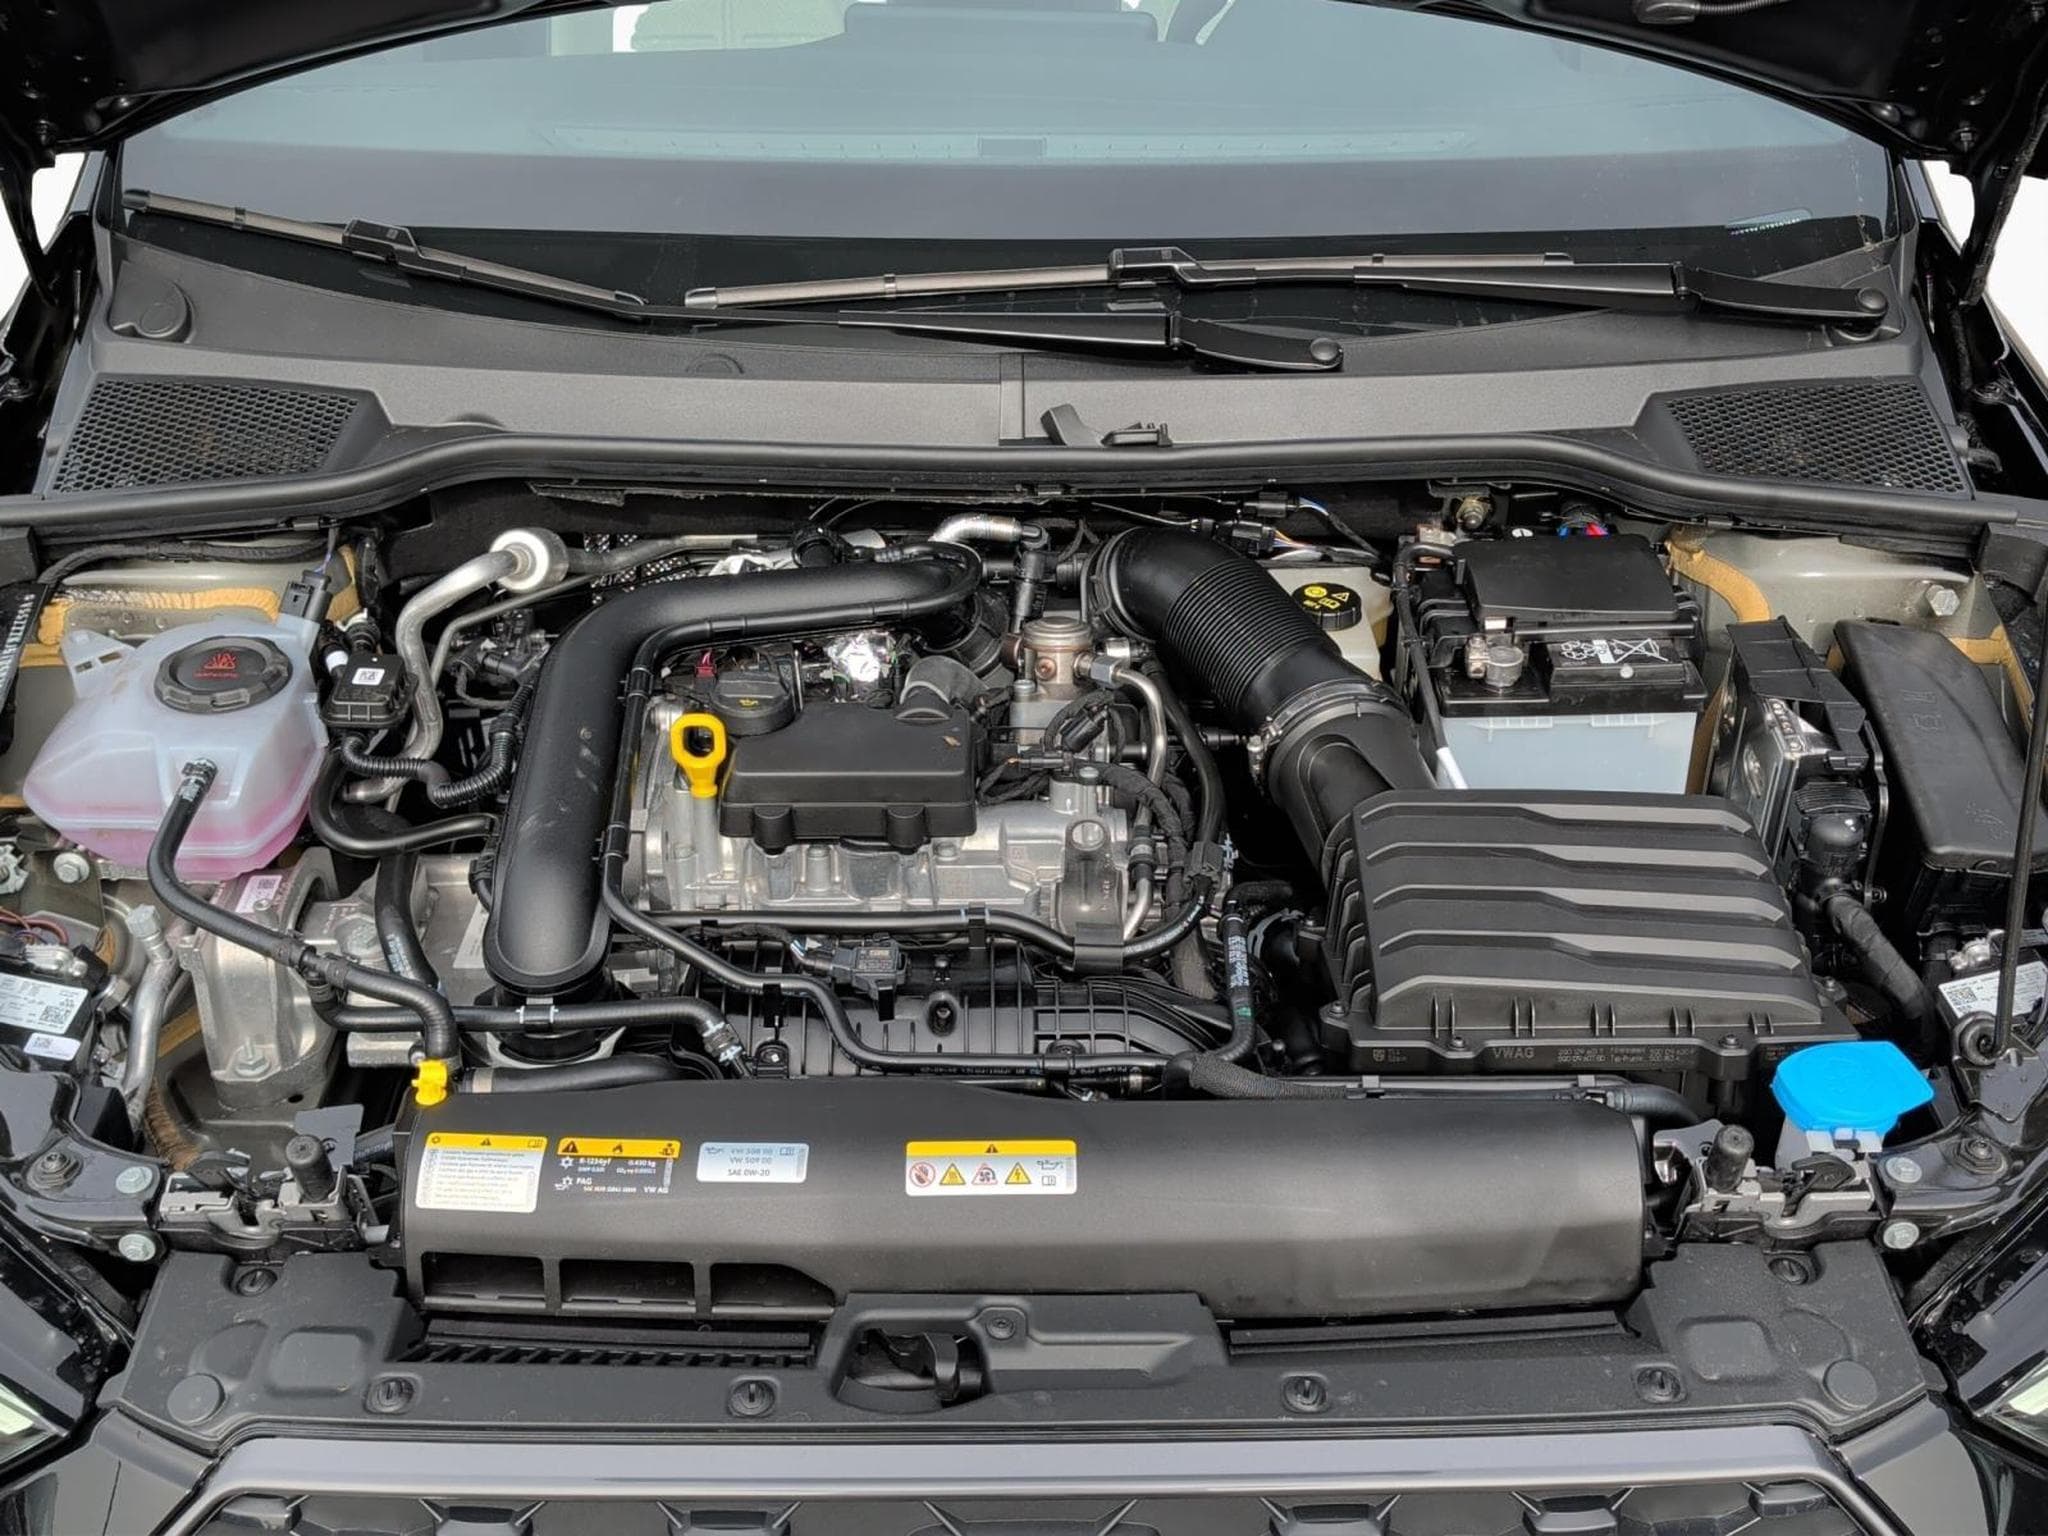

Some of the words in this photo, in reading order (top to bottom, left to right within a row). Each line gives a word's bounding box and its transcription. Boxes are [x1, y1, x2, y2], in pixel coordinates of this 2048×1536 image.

[1492, 1047, 1535, 1059] VWAG
[729, 1157, 743, 1165] VW
[727, 1169, 741, 1177] SAE
[743, 1169, 770, 1177] 0W-20
[576, 1177, 592, 1185] PAG
